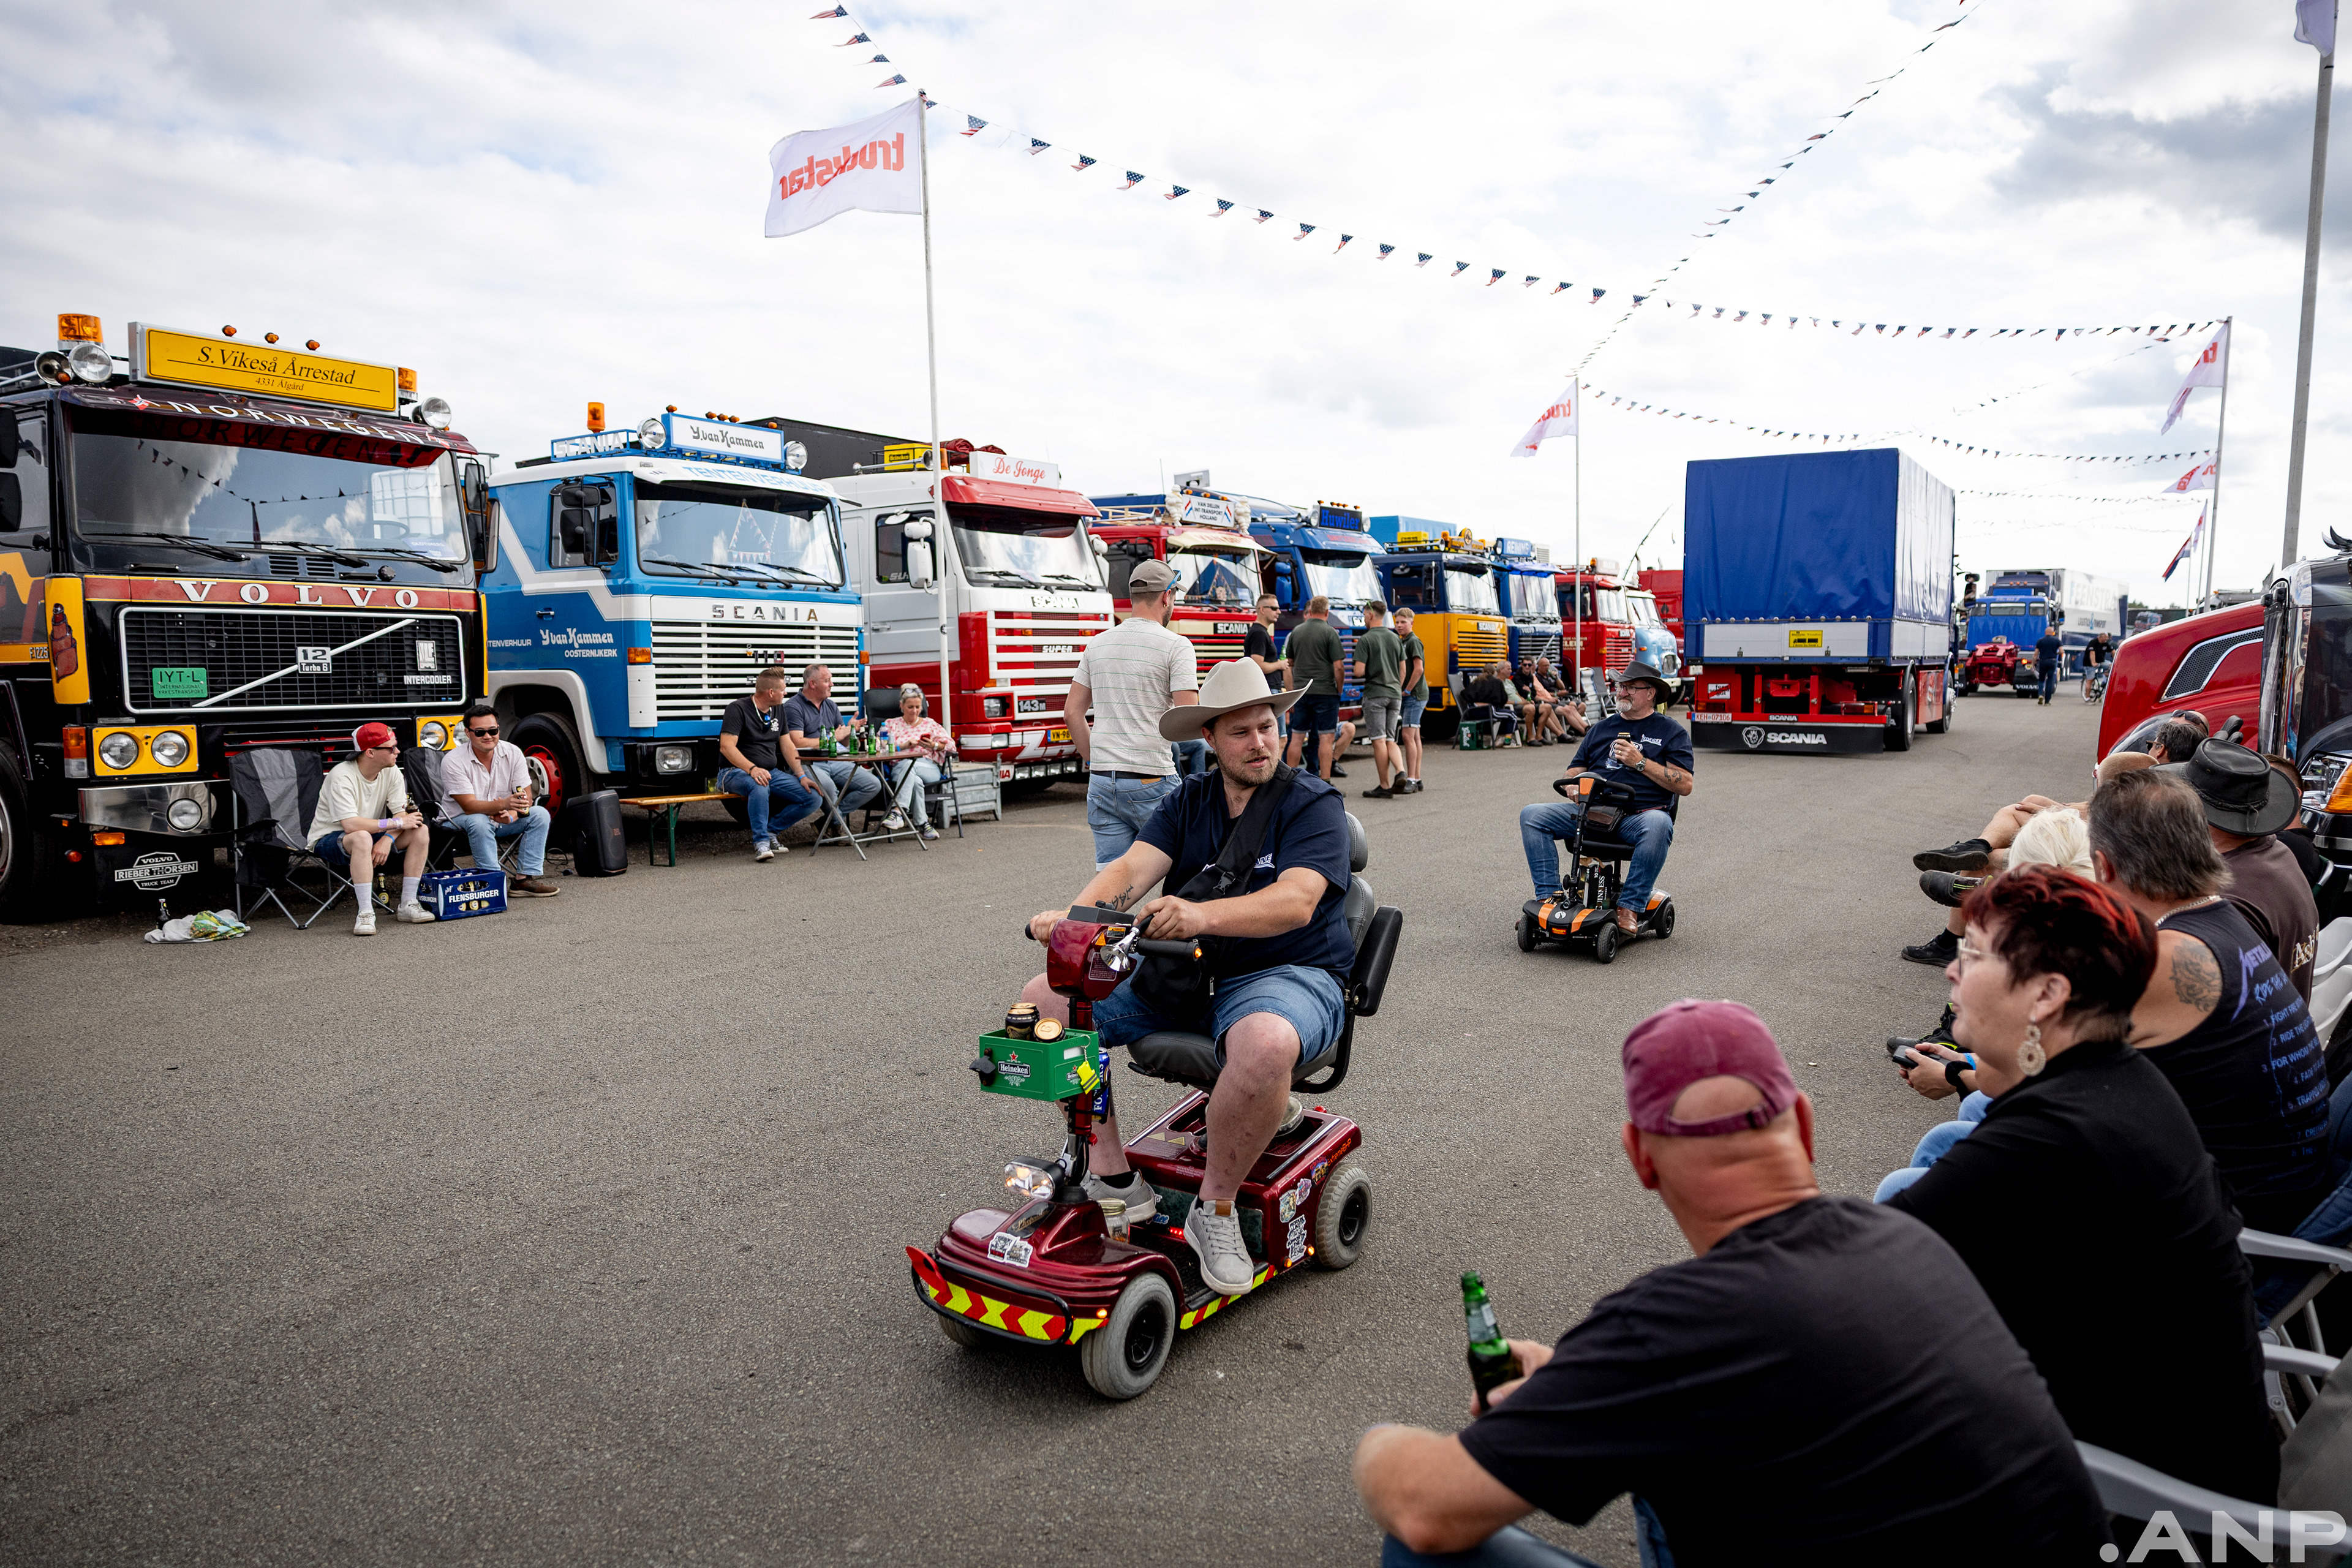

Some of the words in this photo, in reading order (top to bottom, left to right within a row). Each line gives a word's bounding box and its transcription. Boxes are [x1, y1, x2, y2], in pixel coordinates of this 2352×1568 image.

[197, 346, 214, 363] S.
[220, 349, 277, 374] Vikeså
[282, 358, 356, 385] Årrestad
[255, 376, 275, 386] 4331
[277, 380, 304, 391] Ålgård
[168, 401, 425, 446] NORWEGEN
[554, 432, 624, 458] SCANIA
[993, 456, 1011, 475] De
[1321, 510, 1360, 530] Huwiler
[174, 581, 418, 608] VOLVO
[2070, 582, 2117, 611] FEENSTRA
[1033, 597, 1079, 608] SCANIA
[712, 604, 818, 621] SCANIA
[1217, 623, 1249, 634] SCANIA
[1479, 622, 1496, 631] SCANIA
[303, 649, 327, 660] 12
[564, 649, 617, 657] OOSTERNIJKERK
[754, 650, 785, 663] 110
[159, 671, 200, 683] IYT-L
[404, 675, 452, 685] INTERCOOLER
[1767, 733, 1827, 745] SCANIA
[118, 869, 150, 879] RIEBER
[153, 864, 195, 875] THORSEN
[449, 889, 499, 903] FLENSBURGER
[2280, 1029, 2295, 1043] RIDE
[2272, 1056, 2289, 1069] FOR
[2288, 1046, 2309, 1063] WHOM
[1000, 1063, 1029, 1075] Heineken
